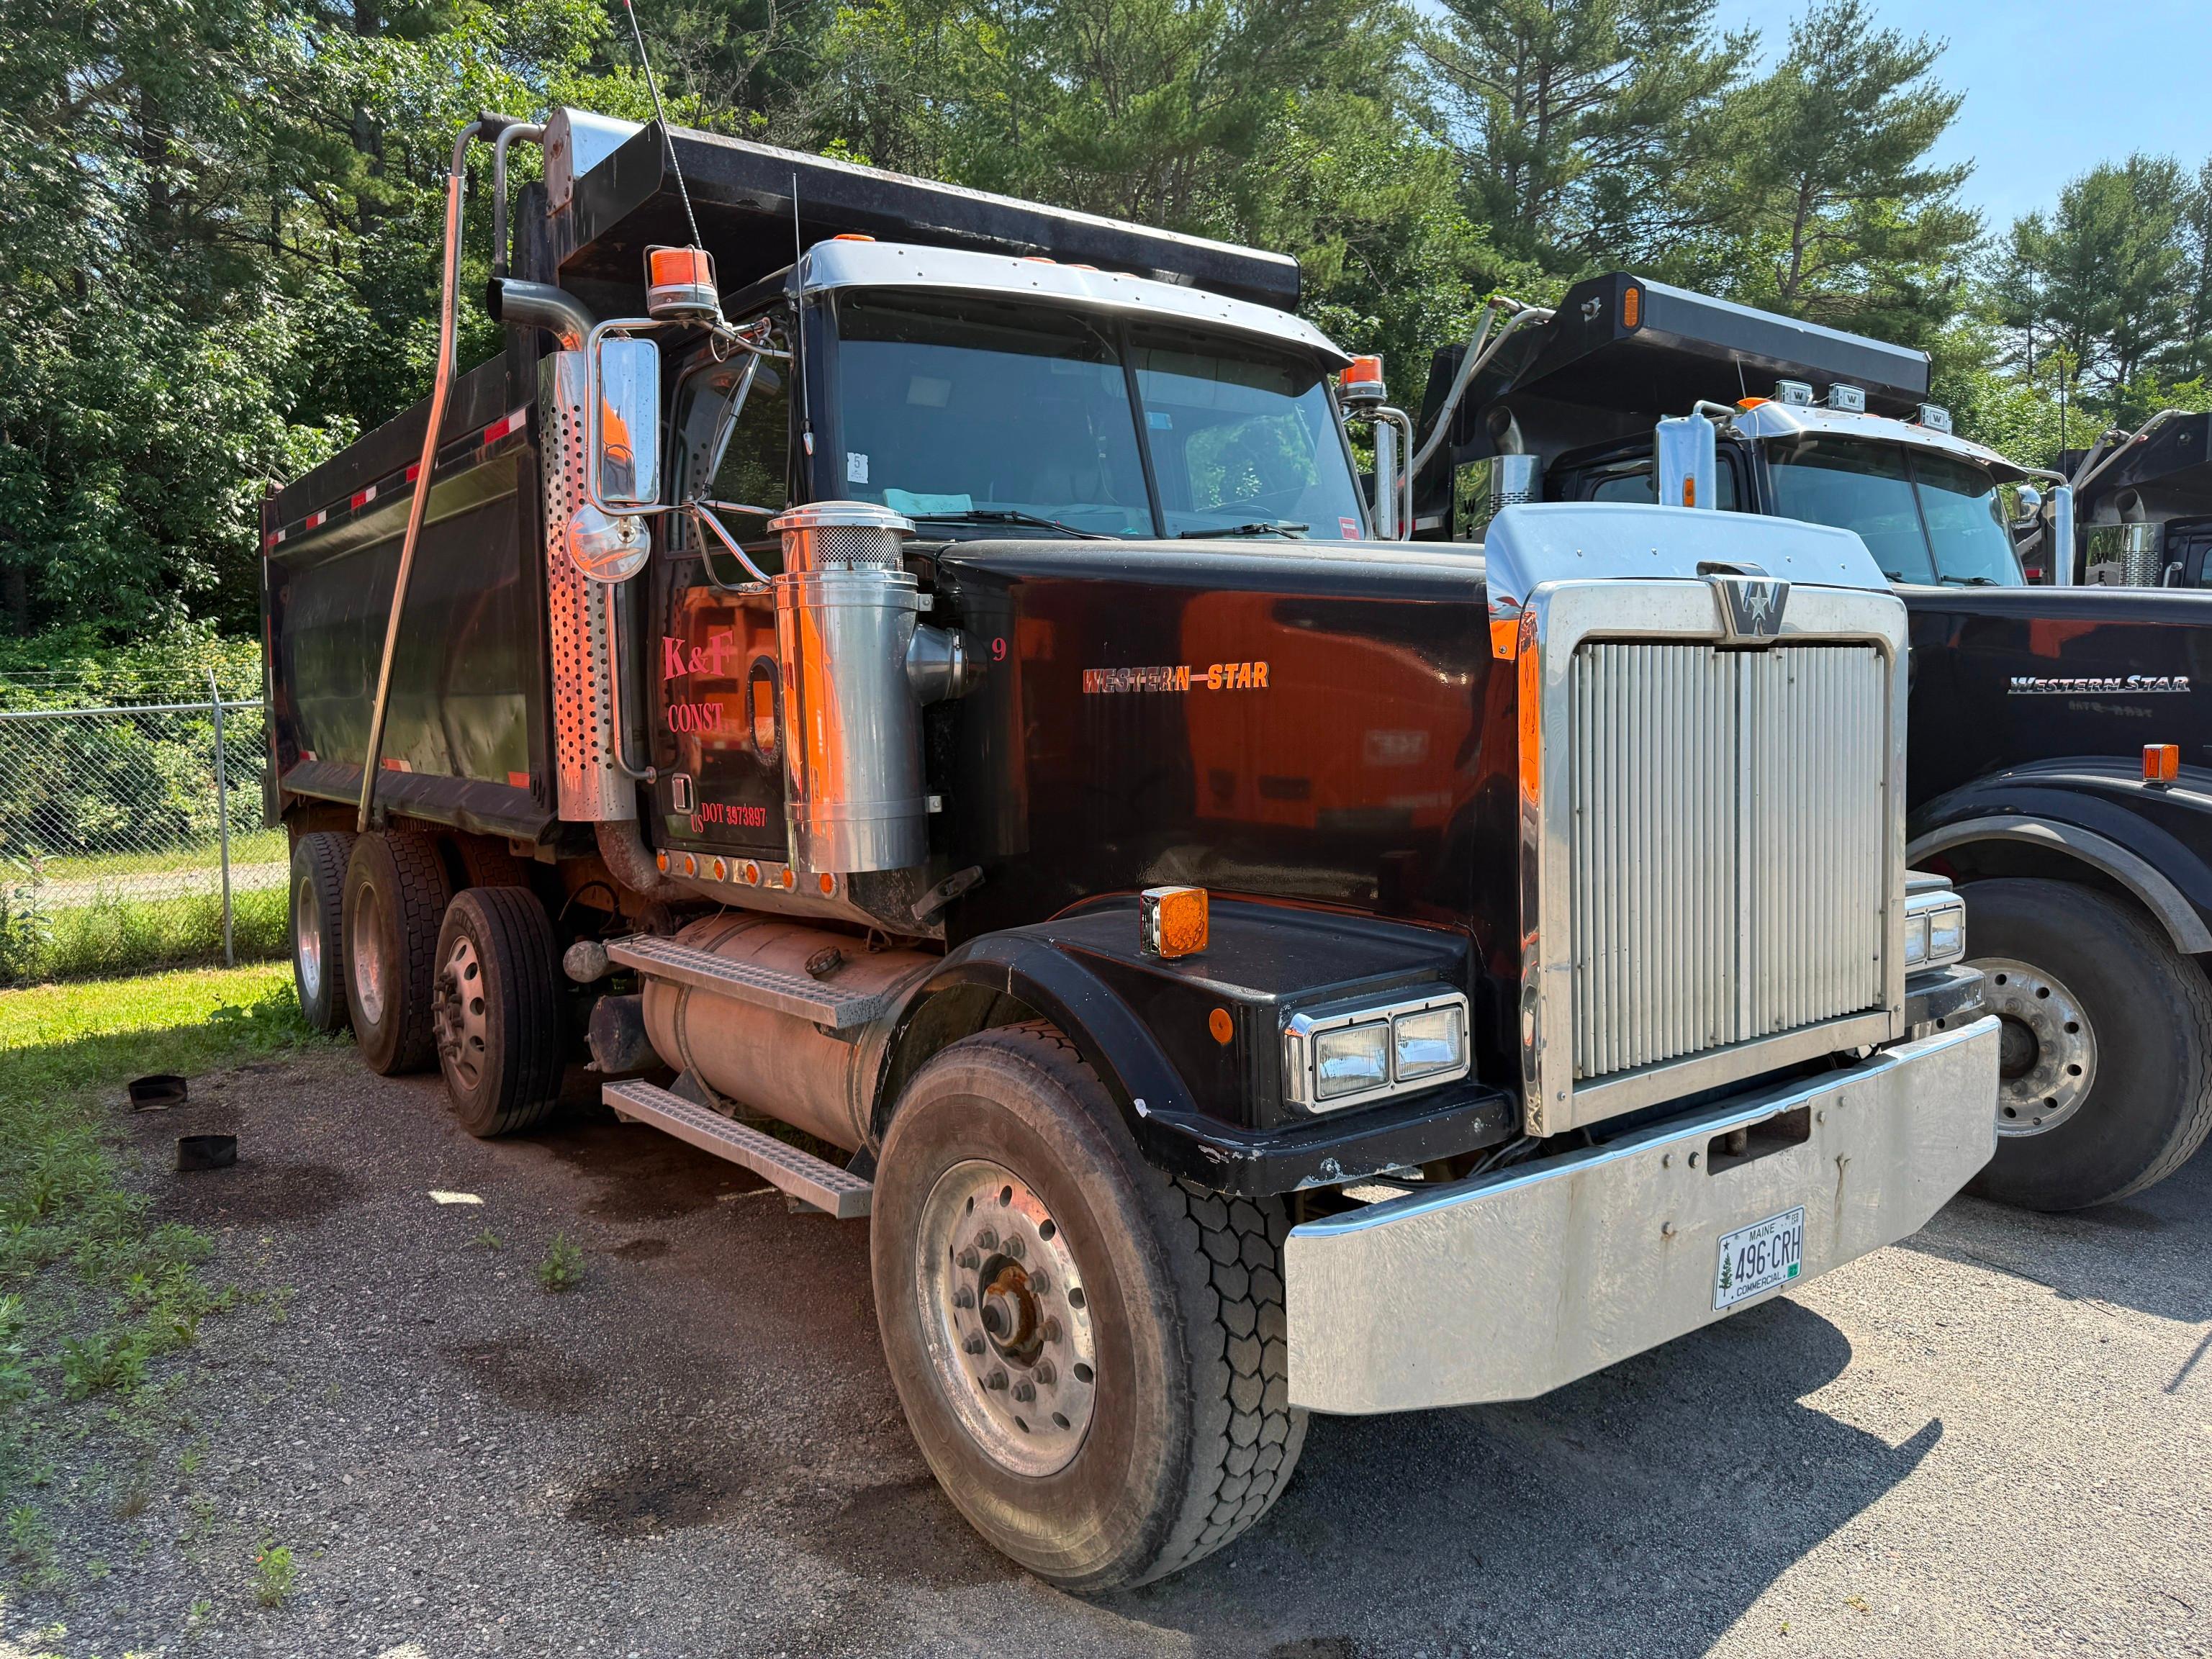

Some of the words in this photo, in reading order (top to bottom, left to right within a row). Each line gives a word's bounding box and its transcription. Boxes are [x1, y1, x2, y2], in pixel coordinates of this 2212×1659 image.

[1847, 394, 1857, 404] W
[1932, 414, 1942, 423] W
[991, 637, 1007, 661] 9
[1083, 665, 1191, 694] WESTERN
[1207, 661, 1270, 692] STAR
[2009, 676, 2122, 693] WESTERN
[2124, 674, 2190, 692] STAR
[691, 814, 704, 833] US
[702, 803, 724, 823] DOT
[726, 805, 767, 827] 3973897
[1748, 1222, 1776, 1242] MAINE
[1736, 1271, 1782, 1297] COMMERCIAL
